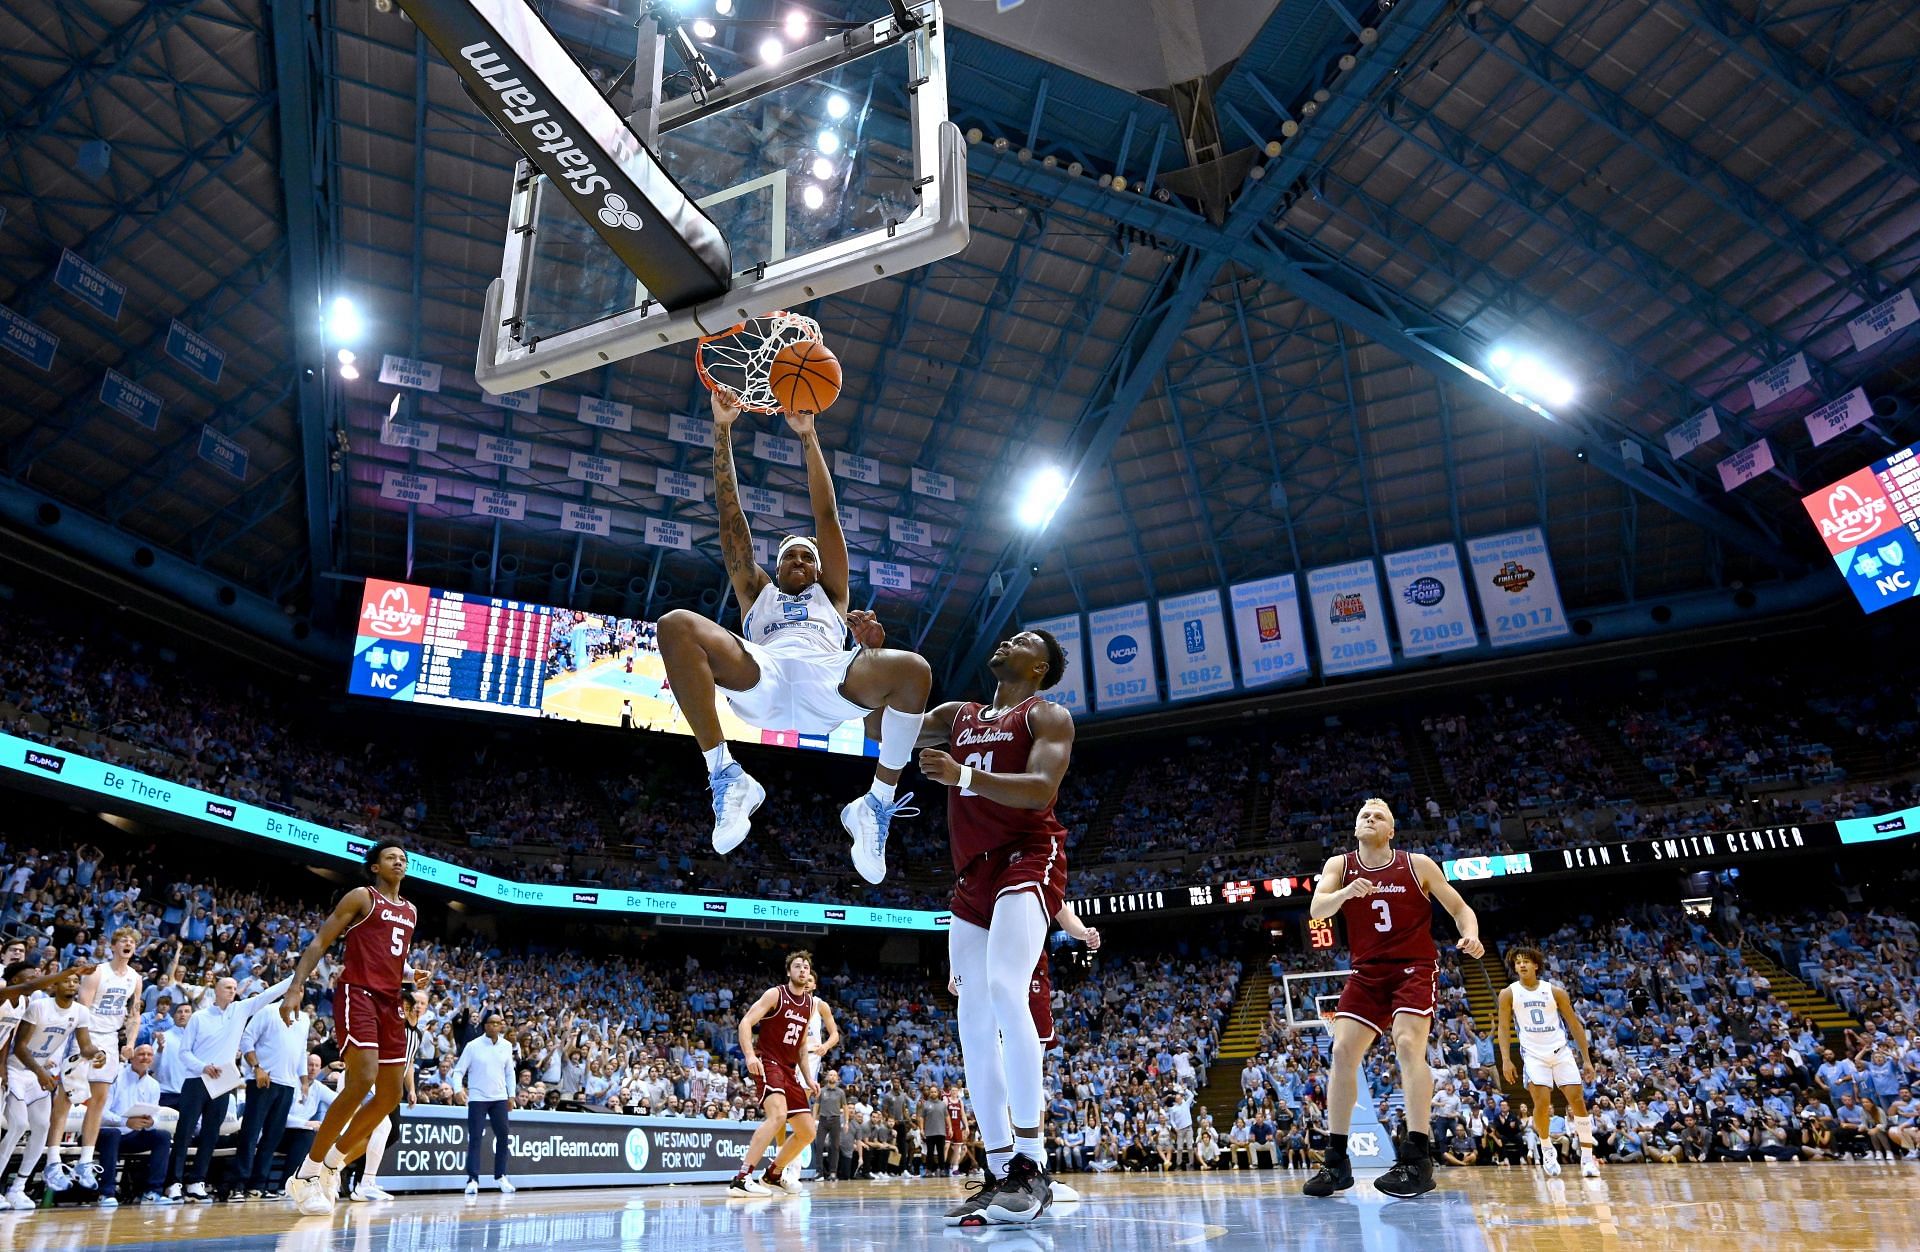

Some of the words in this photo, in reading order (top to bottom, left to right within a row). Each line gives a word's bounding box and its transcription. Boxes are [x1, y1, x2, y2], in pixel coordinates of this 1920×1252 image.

[1873, 314, 1895, 332] 1984
[7, 324, 37, 349] 2005
[1828, 410, 1849, 427] 2017
[488, 504, 510, 517] 2005
[1820, 496, 1887, 537] Arby's
[658, 534, 679, 545] 2009
[881, 577, 900, 586] 2022
[1418, 583, 1440, 592] FINAL
[1875, 570, 1911, 596] NC
[1411, 589, 1440, 600] FOUR
[362, 602, 426, 628] Arby's
[783, 602, 808, 621] 5
[1496, 607, 1552, 632] 2017
[1410, 621, 1464, 644] 2009
[1110, 647, 1137, 659] NCAA
[1331, 639, 1377, 659] 2005
[1252, 652, 1295, 673] 1993
[371, 672, 398, 690] NC
[1179, 665, 1223, 685] 1982
[1104, 678, 1147, 697] 1957
[956, 728, 1015, 747] Charleston
[104, 772, 124, 789] Be
[131, 778, 172, 802] There
[266, 818, 283, 833] Be
[288, 823, 320, 843] There
[411, 859, 437, 876] There
[497, 883, 509, 895] Be
[513, 887, 544, 900] There
[626, 896, 641, 906] Be
[645, 897, 677, 908] There
[753, 905, 767, 914] Be
[771, 906, 799, 917] There
[870, 912, 883, 922] Be
[886, 914, 912, 924] There
[1563, 846, 1611, 869] DEAN
[1651, 836, 1715, 860] SMITH
[1726, 827, 1804, 853] CENTER
[1066, 898, 1101, 916] MITH
[1110, 891, 1164, 912] CENTER
[381, 909, 415, 928] Charleston
[1309, 918, 1333, 930] 10:51
[1371, 899, 1392, 932] 3
[390, 926, 404, 956] 5
[1311, 929, 1333, 947] 30
[98, 995, 126, 1009] 24
[1530, 1008, 1545, 1024] 0
[41, 1035, 54, 1051] 1
[783, 1022, 803, 1046] 25
[633, 1106, 647, 1114] POSS
[399, 1123, 412, 1144] E
[414, 1124, 464, 1145] STAND
[654, 1133, 670, 1148] WE
[670, 1133, 700, 1148] STAND
[700, 1133, 713, 1148] UP
[397, 1150, 430, 1172] FOR
[434, 1151, 467, 1171] YOU
[662, 1152, 682, 1168] FOR
